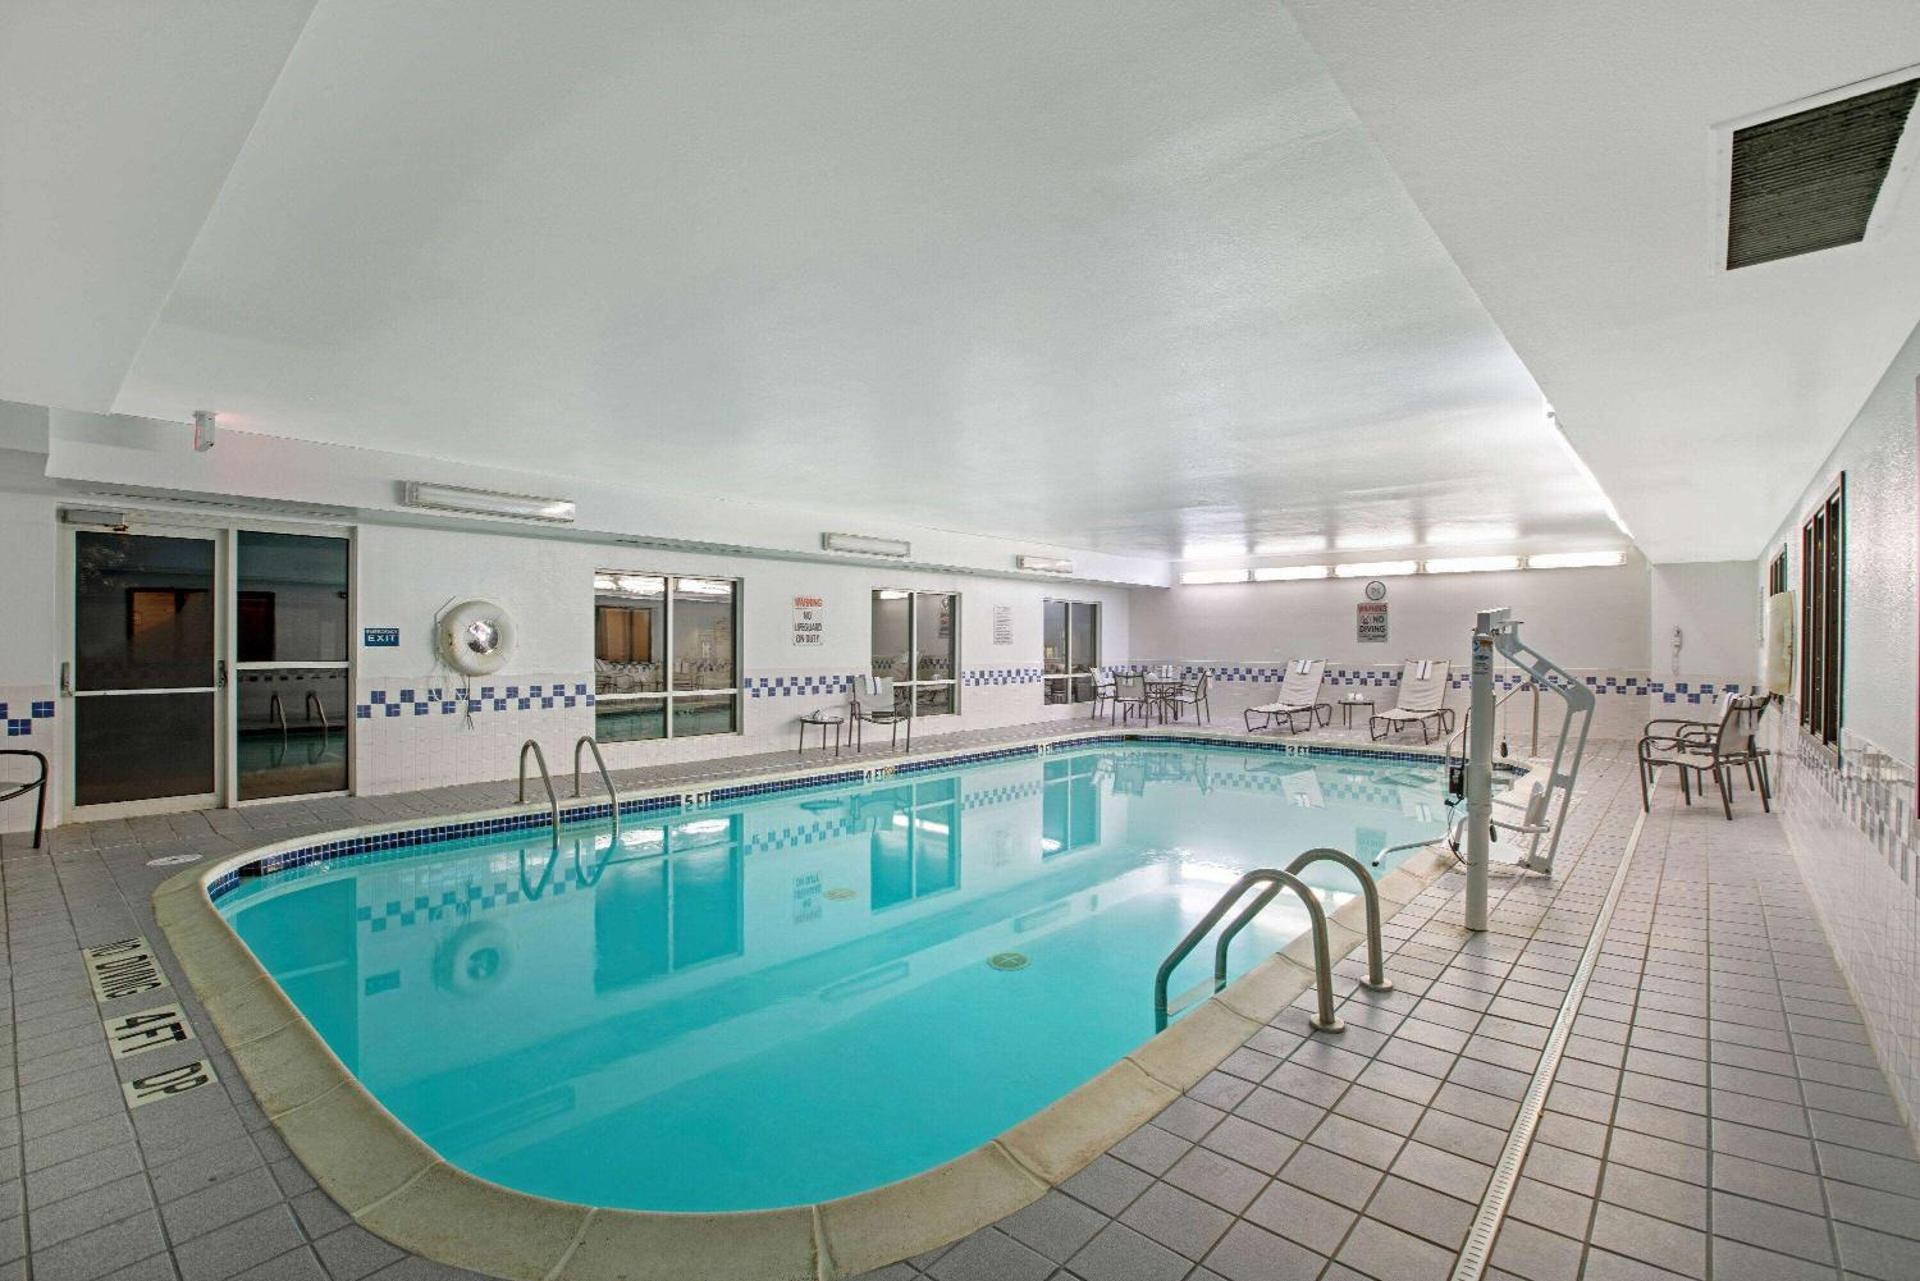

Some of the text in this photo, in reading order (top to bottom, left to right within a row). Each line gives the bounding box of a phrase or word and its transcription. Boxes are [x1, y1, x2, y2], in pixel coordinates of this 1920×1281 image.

[794, 597, 823, 607] WARNING
[1358, 603, 1387, 612] WARNING
[803, 610, 813, 620] NO
[1372, 615, 1385, 624] NO
[794, 622, 822, 632] LIFEGUARD
[1359, 625, 1386, 633] DIVING
[368, 634, 396, 642] EXIT
[796, 634, 820, 643] ON DUTY
[697, 791, 710, 803] FT
[86, 937, 162, 1000] NO DIVING
[132, 1061, 209, 1099] DP
